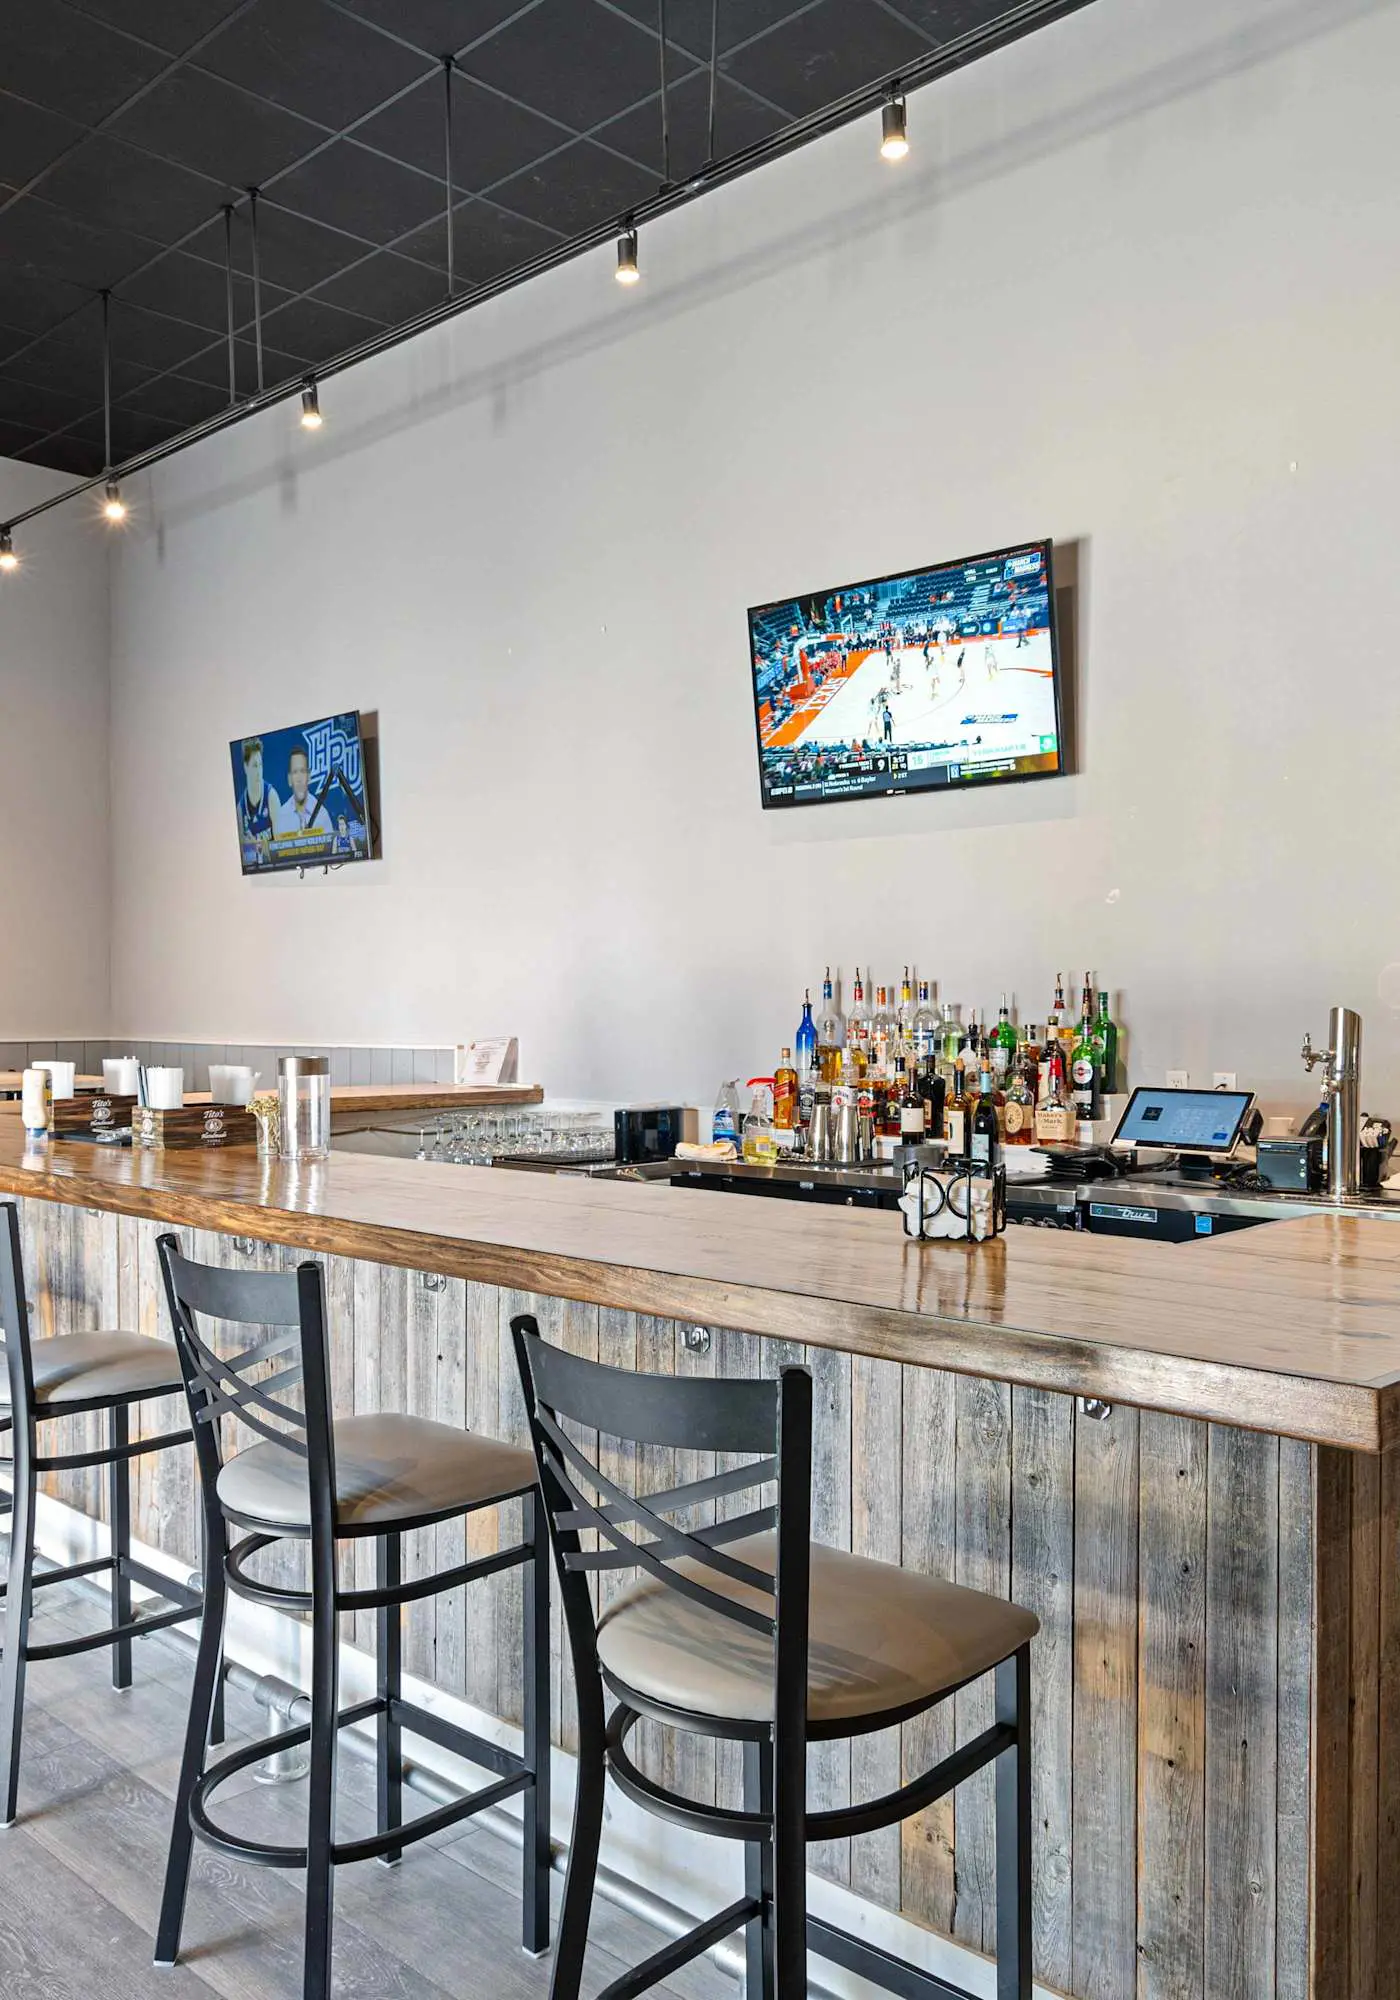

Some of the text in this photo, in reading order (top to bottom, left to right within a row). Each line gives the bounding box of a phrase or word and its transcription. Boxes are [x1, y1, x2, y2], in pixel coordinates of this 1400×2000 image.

[302, 718, 363, 795] HPU
[877, 758, 885, 771] 9
[203, 1110, 225, 1119] Tito's
[1117, 1207, 1153, 1220] True
